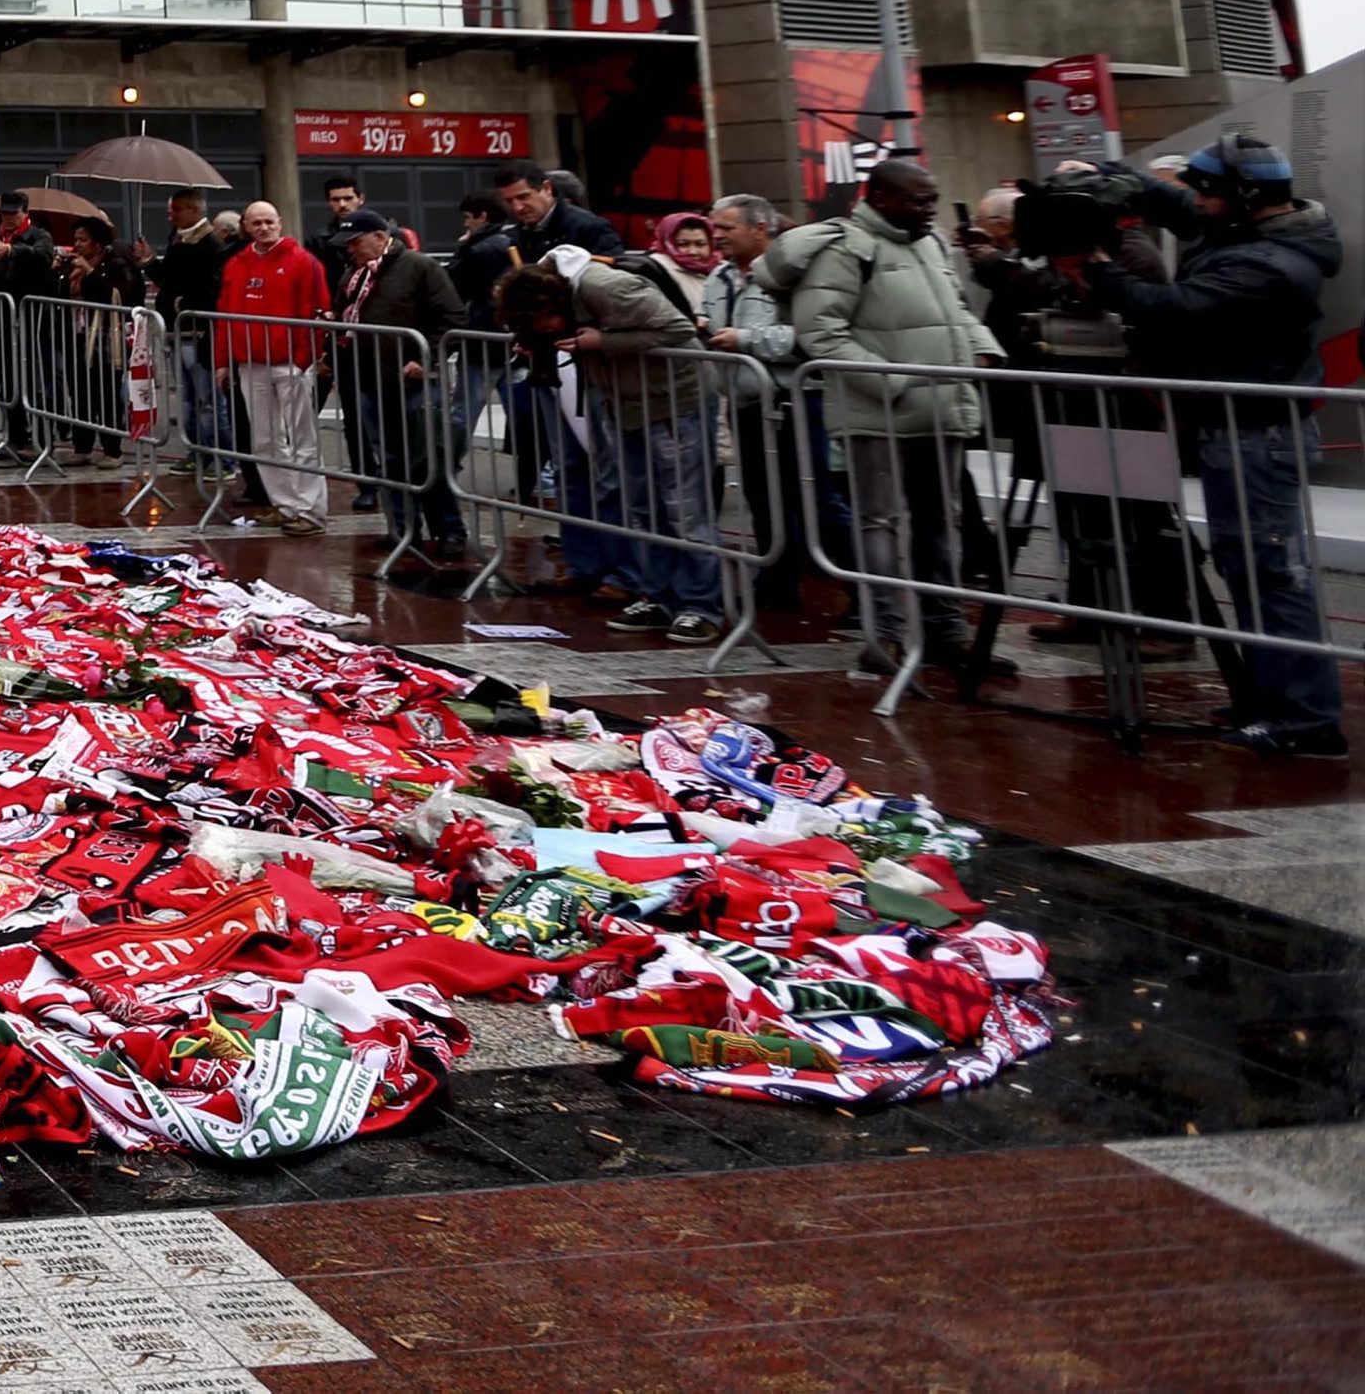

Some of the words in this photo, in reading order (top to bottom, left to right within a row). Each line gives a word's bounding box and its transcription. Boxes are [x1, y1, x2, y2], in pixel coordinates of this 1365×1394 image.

[310, 130, 338, 143] MEO
[360, 127, 406, 152] 19/17
[430, 129, 456, 154] 19
[486, 131, 513, 154] 20
